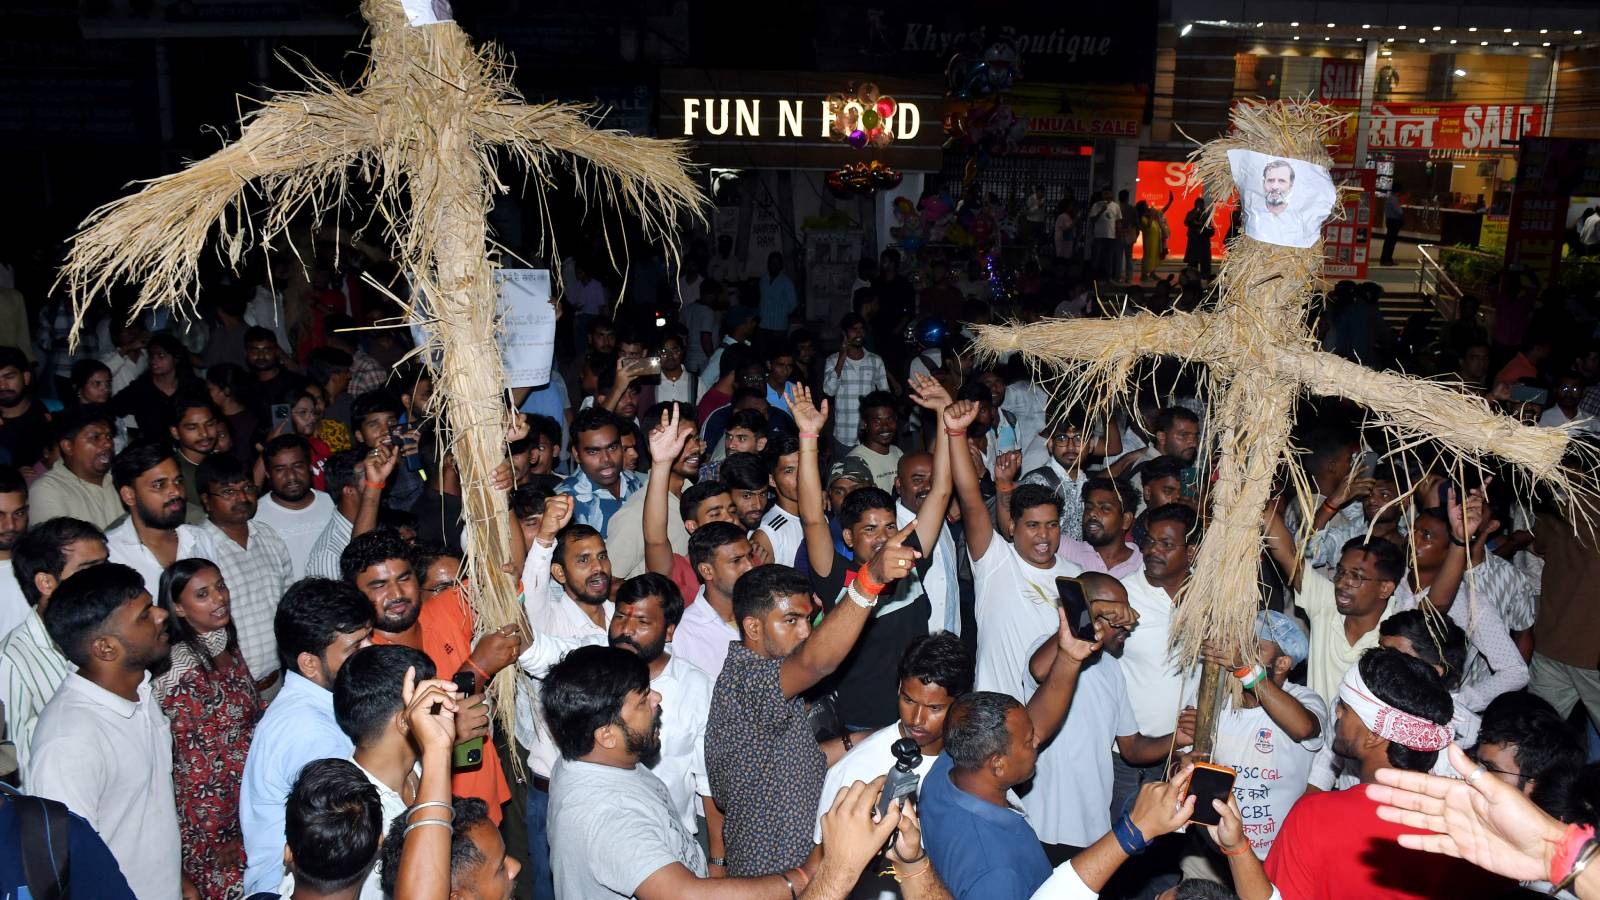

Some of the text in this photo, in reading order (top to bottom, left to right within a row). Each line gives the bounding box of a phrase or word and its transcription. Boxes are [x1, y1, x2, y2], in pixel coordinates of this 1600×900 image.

[903, 23, 986, 57] Khyi
[683, 98, 761, 136] FUN
[778, 100, 804, 137] N
[1027, 117, 1137, 133] NNUAL SALE
[1462, 104, 1534, 149] SALE
[1231, 765, 1283, 781] PSC CGL
[1248, 784, 1270, 800] करो
[1241, 805, 1272, 819] CBI
